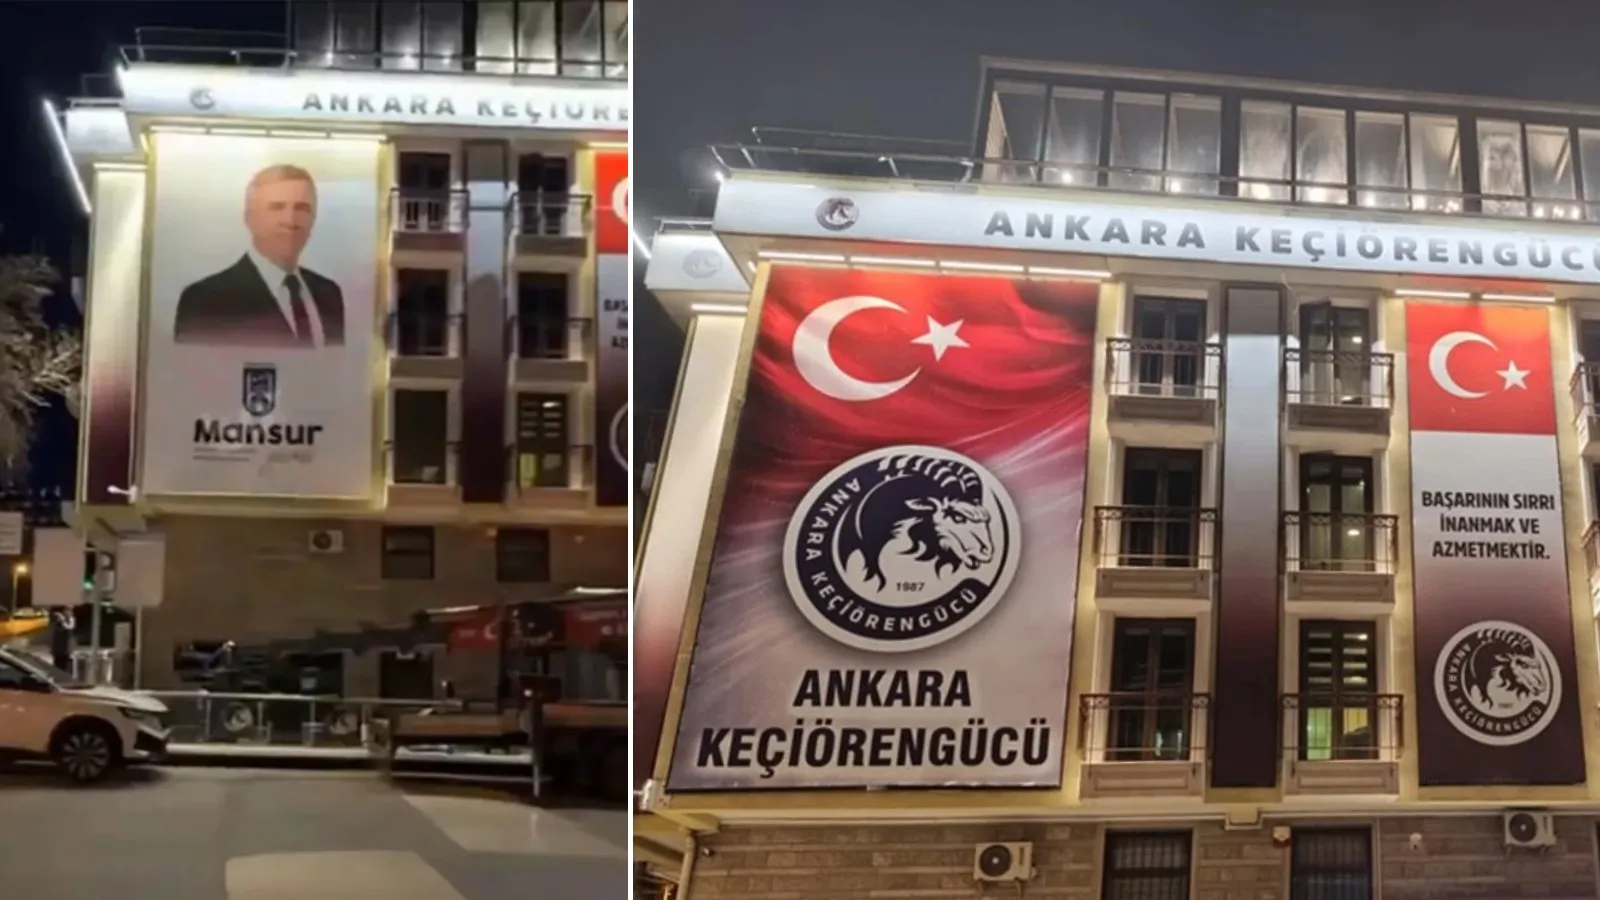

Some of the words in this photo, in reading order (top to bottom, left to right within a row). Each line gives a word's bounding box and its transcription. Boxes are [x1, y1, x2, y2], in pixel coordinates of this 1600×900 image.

[302, 92, 457, 116] ANKARA
[984, 210, 1206, 249] ANKARA
[193, 418, 323, 446] Mansur
[1421, 491, 1510, 510] BAŞARININ
[1513, 493, 1555, 510] SIRRI
[806, 478, 861, 561] ANKARA
[1440, 513, 1516, 534] İNANMAK
[1519, 518, 1540, 534] VE
[1432, 540, 1550, 560] AZMETMEKTİR.
[896, 582, 926, 592] 1987
[811, 571, 977, 632] KEÇİÖRENGÜCÜ
[793, 669, 972, 707] ANKARA
[697, 718, 1051, 778] KEÇİÖRENGÜCÜ
